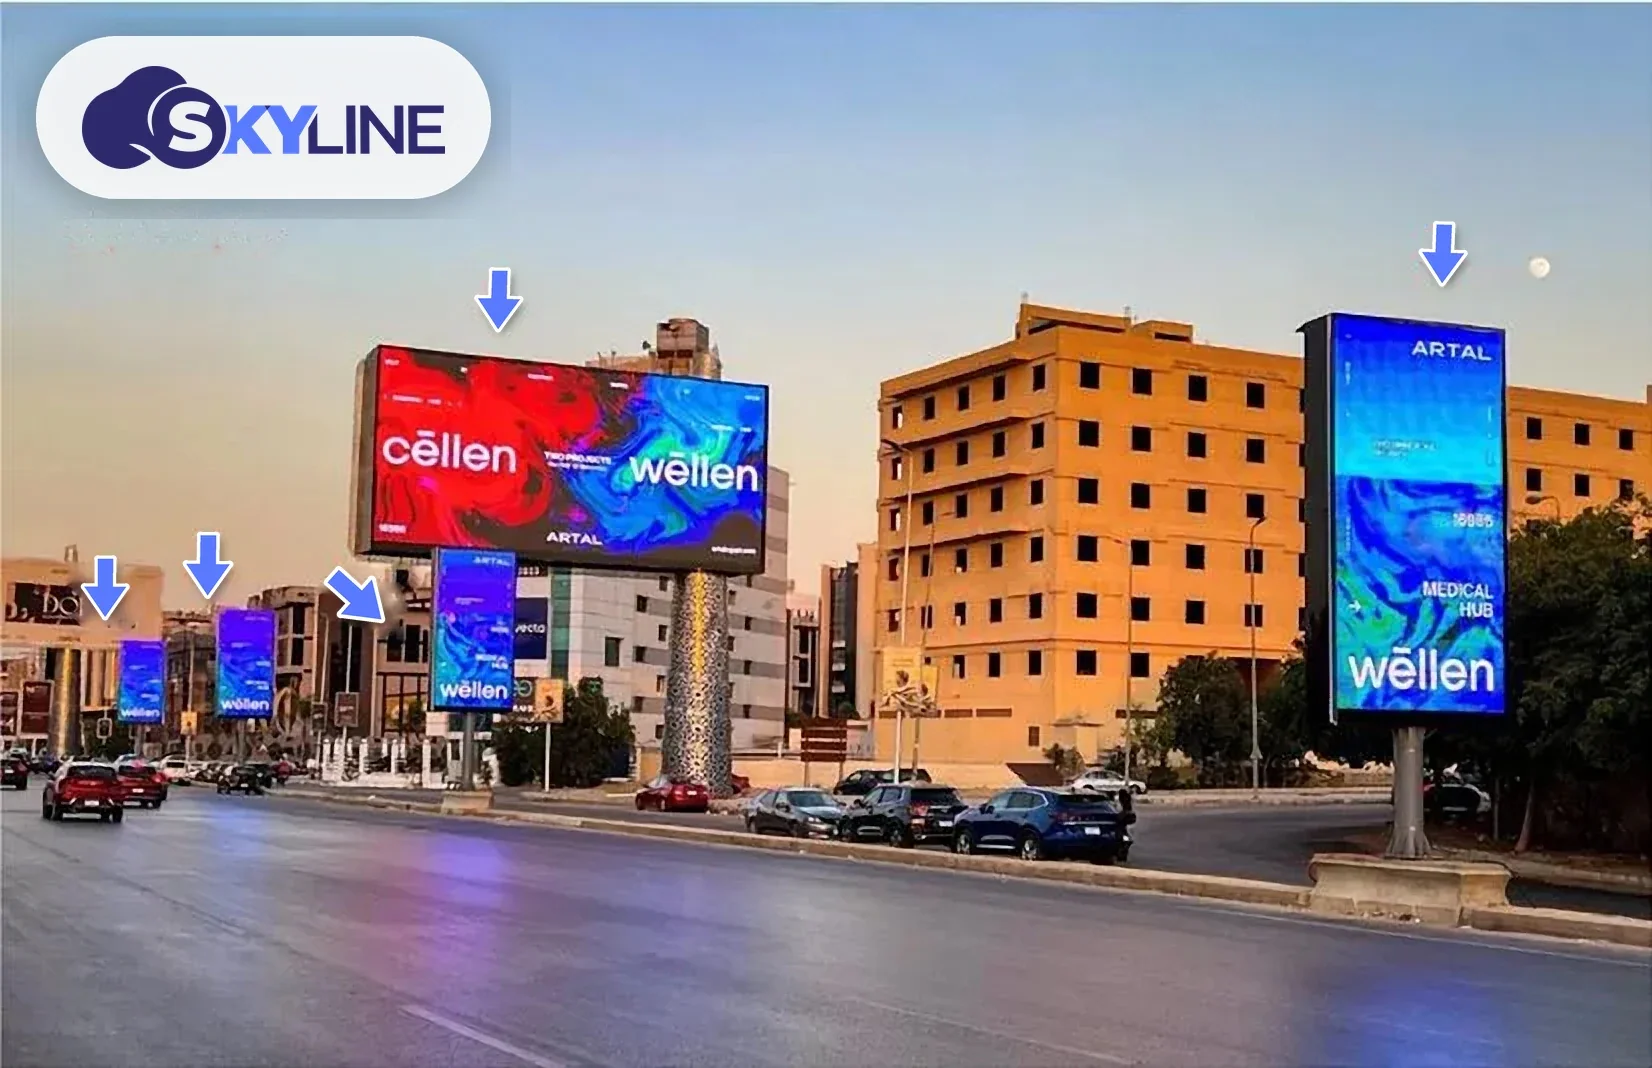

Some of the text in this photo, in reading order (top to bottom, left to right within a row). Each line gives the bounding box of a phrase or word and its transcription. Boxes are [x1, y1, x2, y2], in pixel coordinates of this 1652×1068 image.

[1411, 340, 1492, 361] ARTAL
[382, 430, 517, 474] cēllen
[629, 451, 759, 492] wēllen
[545, 531, 603, 546] ARTAL
[1422, 581, 1494, 599] MEDICAL
[1459, 602, 1494, 618] HUB
[1348, 646, 1495, 692] wēllen
